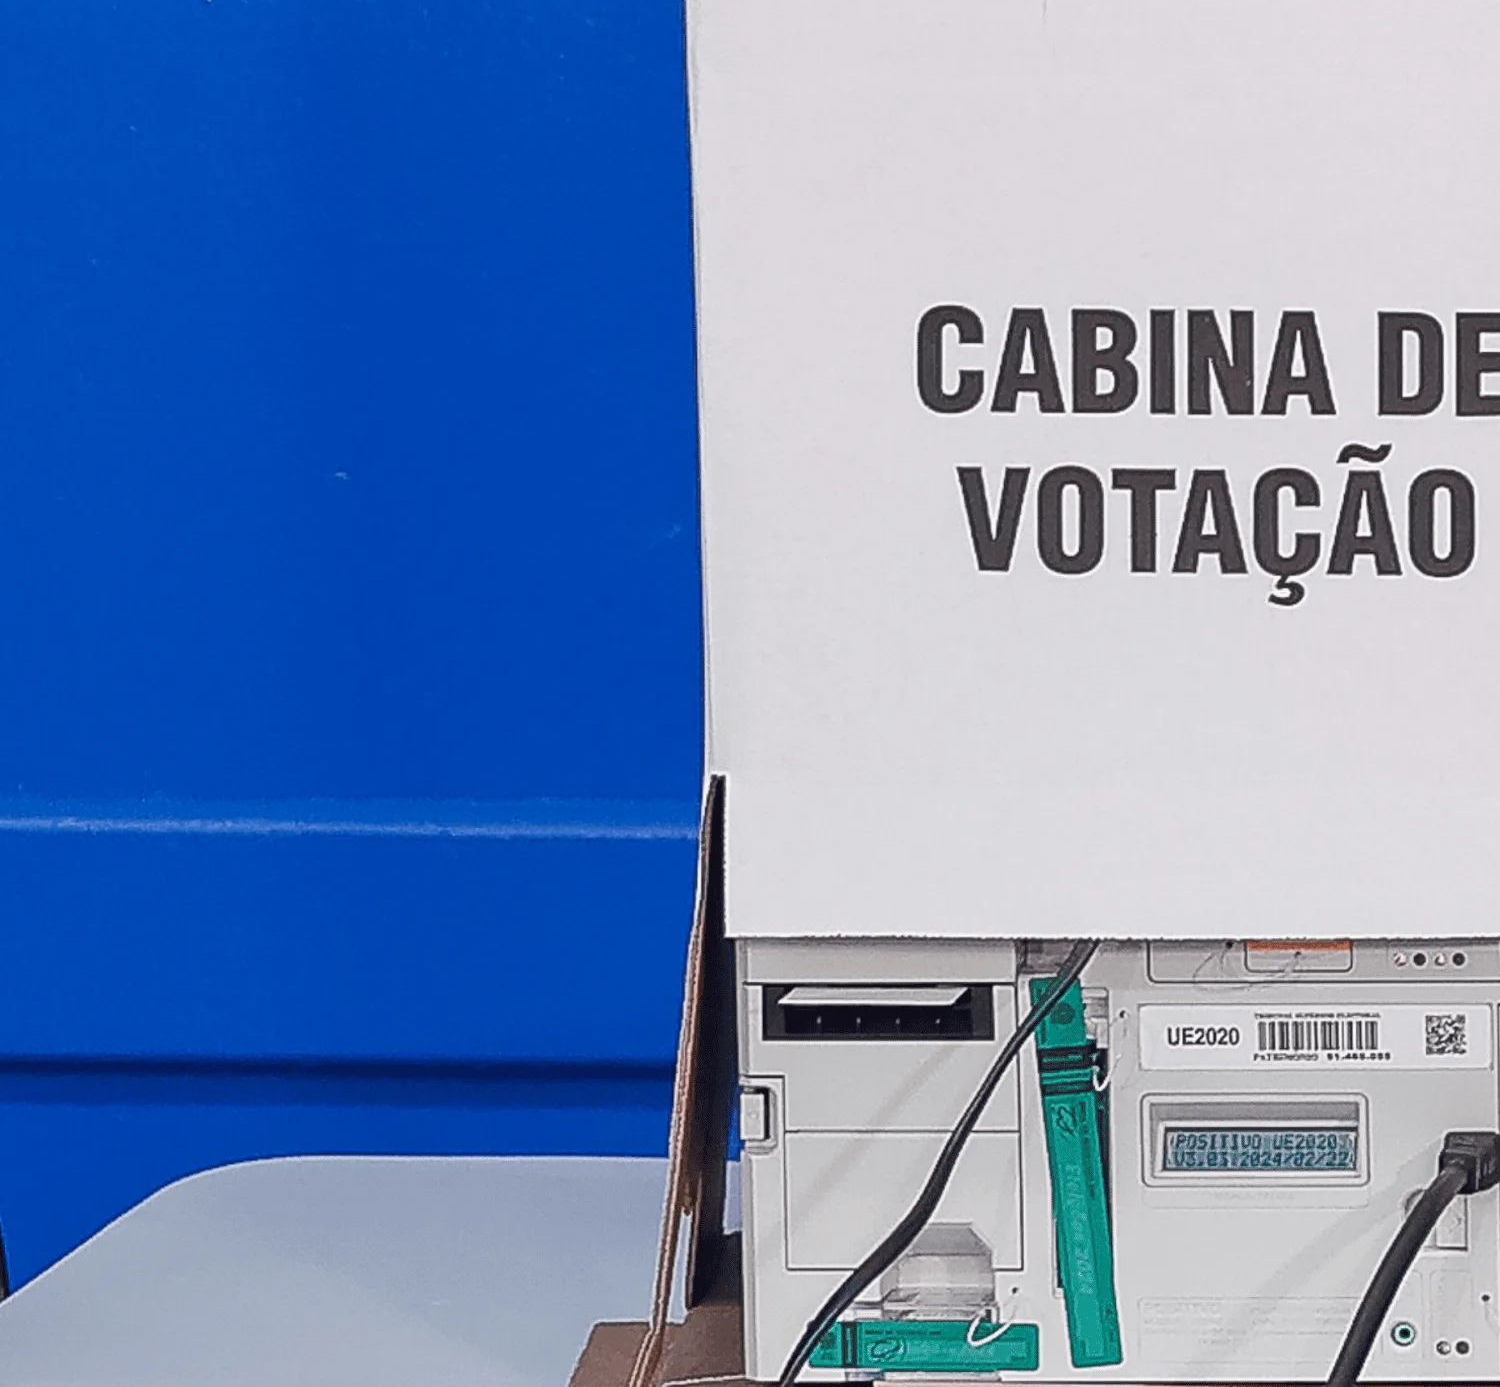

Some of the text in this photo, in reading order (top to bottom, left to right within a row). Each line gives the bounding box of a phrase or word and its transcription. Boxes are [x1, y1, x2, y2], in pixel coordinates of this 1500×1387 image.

[915, 303, 1337, 416] CABINA
[956, 442, 1476, 607] VOTAÇÃO
[1166, 1026, 1240, 1046] UE2020
[1175, 1134, 1337, 1150] POSITIVO UE2020
